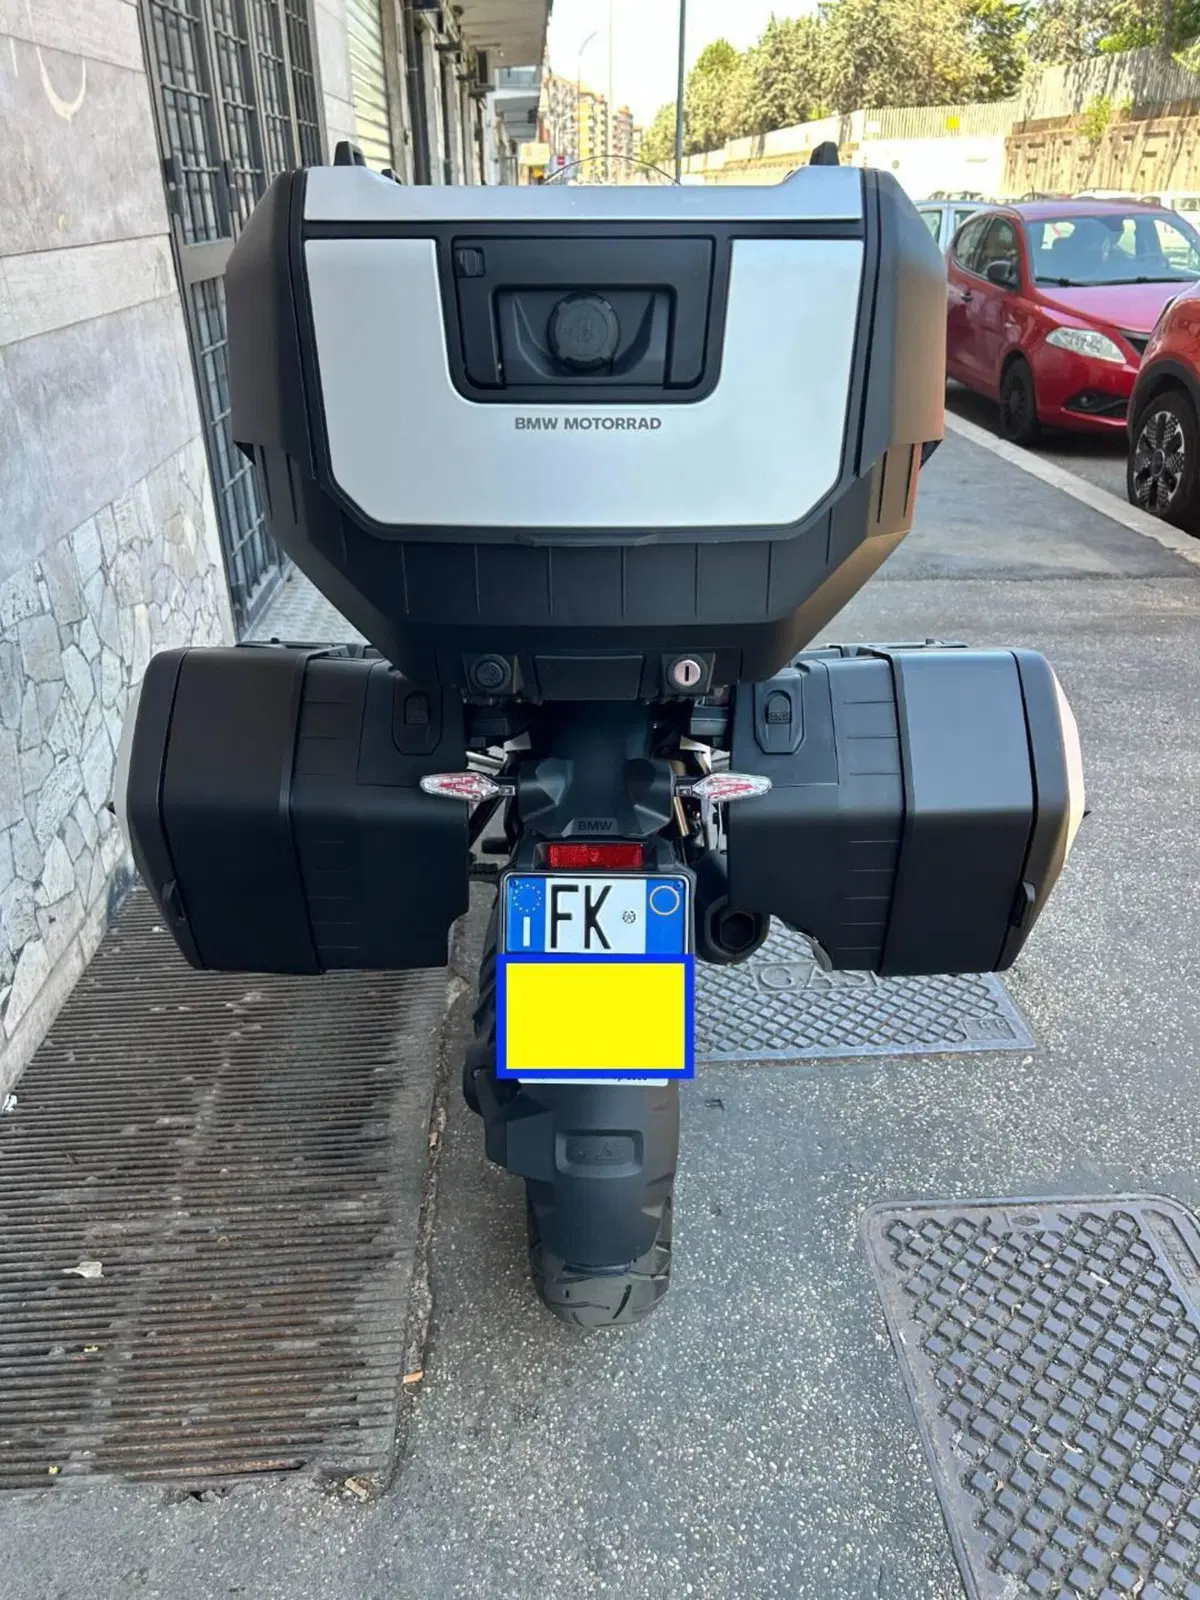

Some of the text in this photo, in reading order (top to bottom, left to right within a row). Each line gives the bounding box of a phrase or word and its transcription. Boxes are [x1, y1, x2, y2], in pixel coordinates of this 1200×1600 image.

[514, 417, 662, 430] BMW MOTORRAD
[578, 820, 613, 831] BMW
[760, 965, 868, 988] GAS
